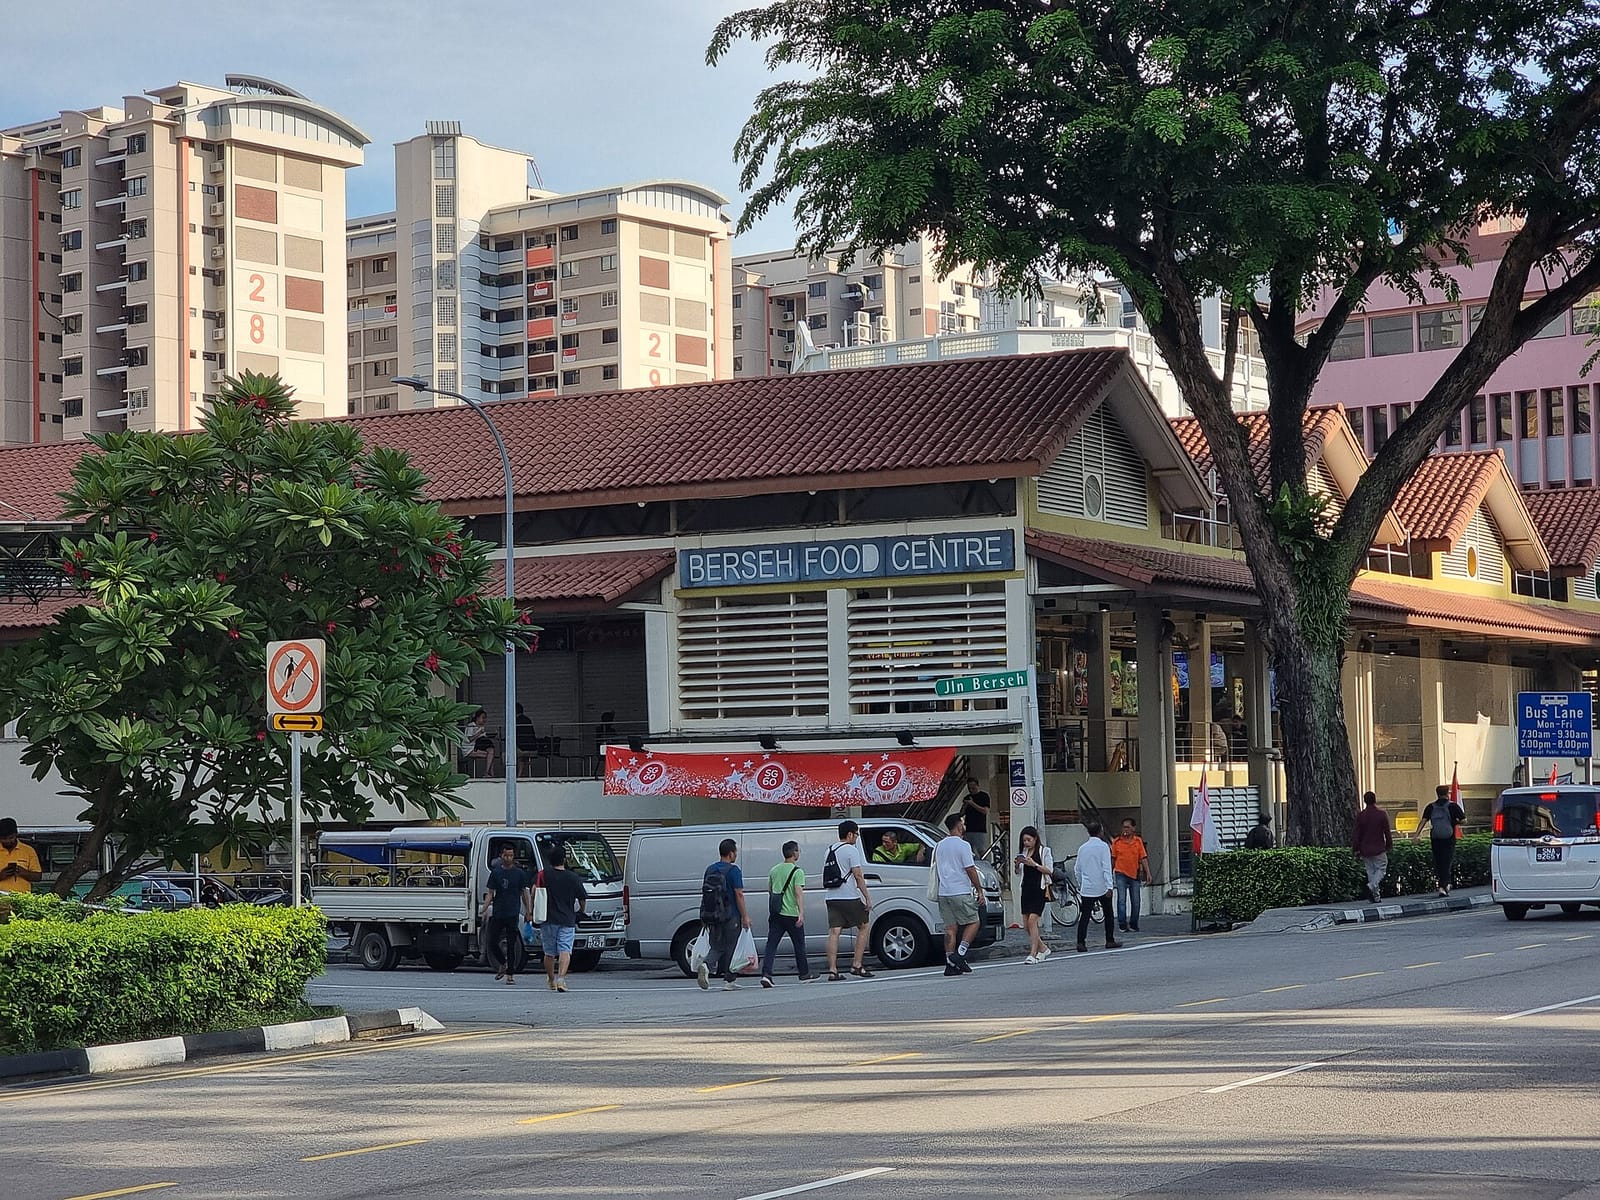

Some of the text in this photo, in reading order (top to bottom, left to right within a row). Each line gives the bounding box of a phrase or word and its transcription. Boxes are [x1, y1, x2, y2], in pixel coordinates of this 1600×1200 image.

[689, 536, 1002, 582] BERSEH FOOD CENTRE
[944, 673, 1024, 694] Jln Berseh
[1525, 706, 1584, 719] Bus Lane
[646, 766, 659, 774] SG
[764, 769, 779, 778] SG
[882, 769, 897, 778] SG
[643, 773, 656, 781] 60
[762, 777, 777, 787] 60
[880, 777, 895, 787] 60
